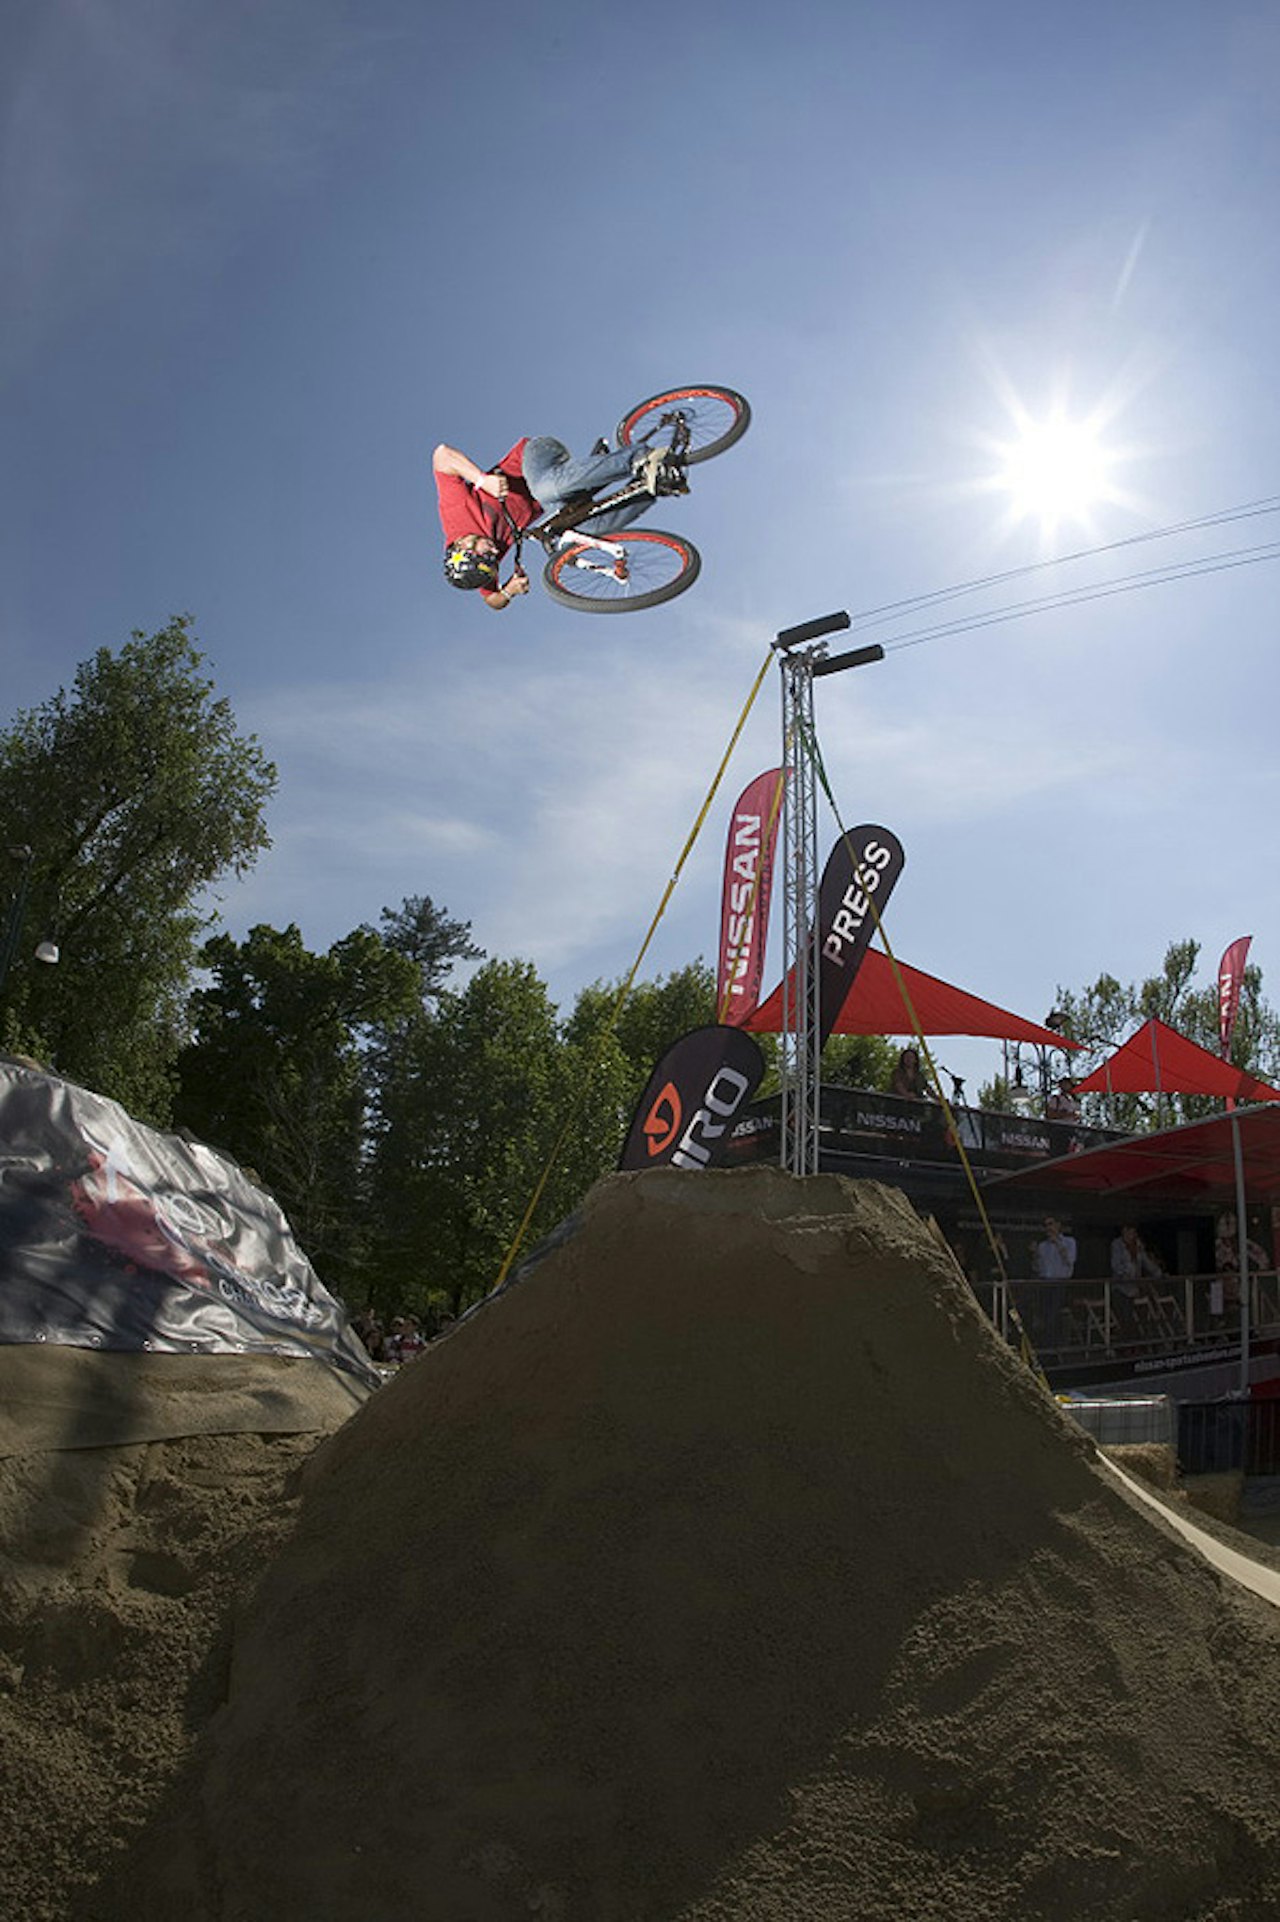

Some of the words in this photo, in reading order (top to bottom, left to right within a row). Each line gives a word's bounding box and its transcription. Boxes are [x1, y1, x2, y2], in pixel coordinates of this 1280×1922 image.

[724, 814, 762, 996] NISSAN
[822, 840, 892, 968] PRESS
[856, 1111, 921, 1133] NISSAN
[1001, 1131, 1051, 1150] NISSAN
